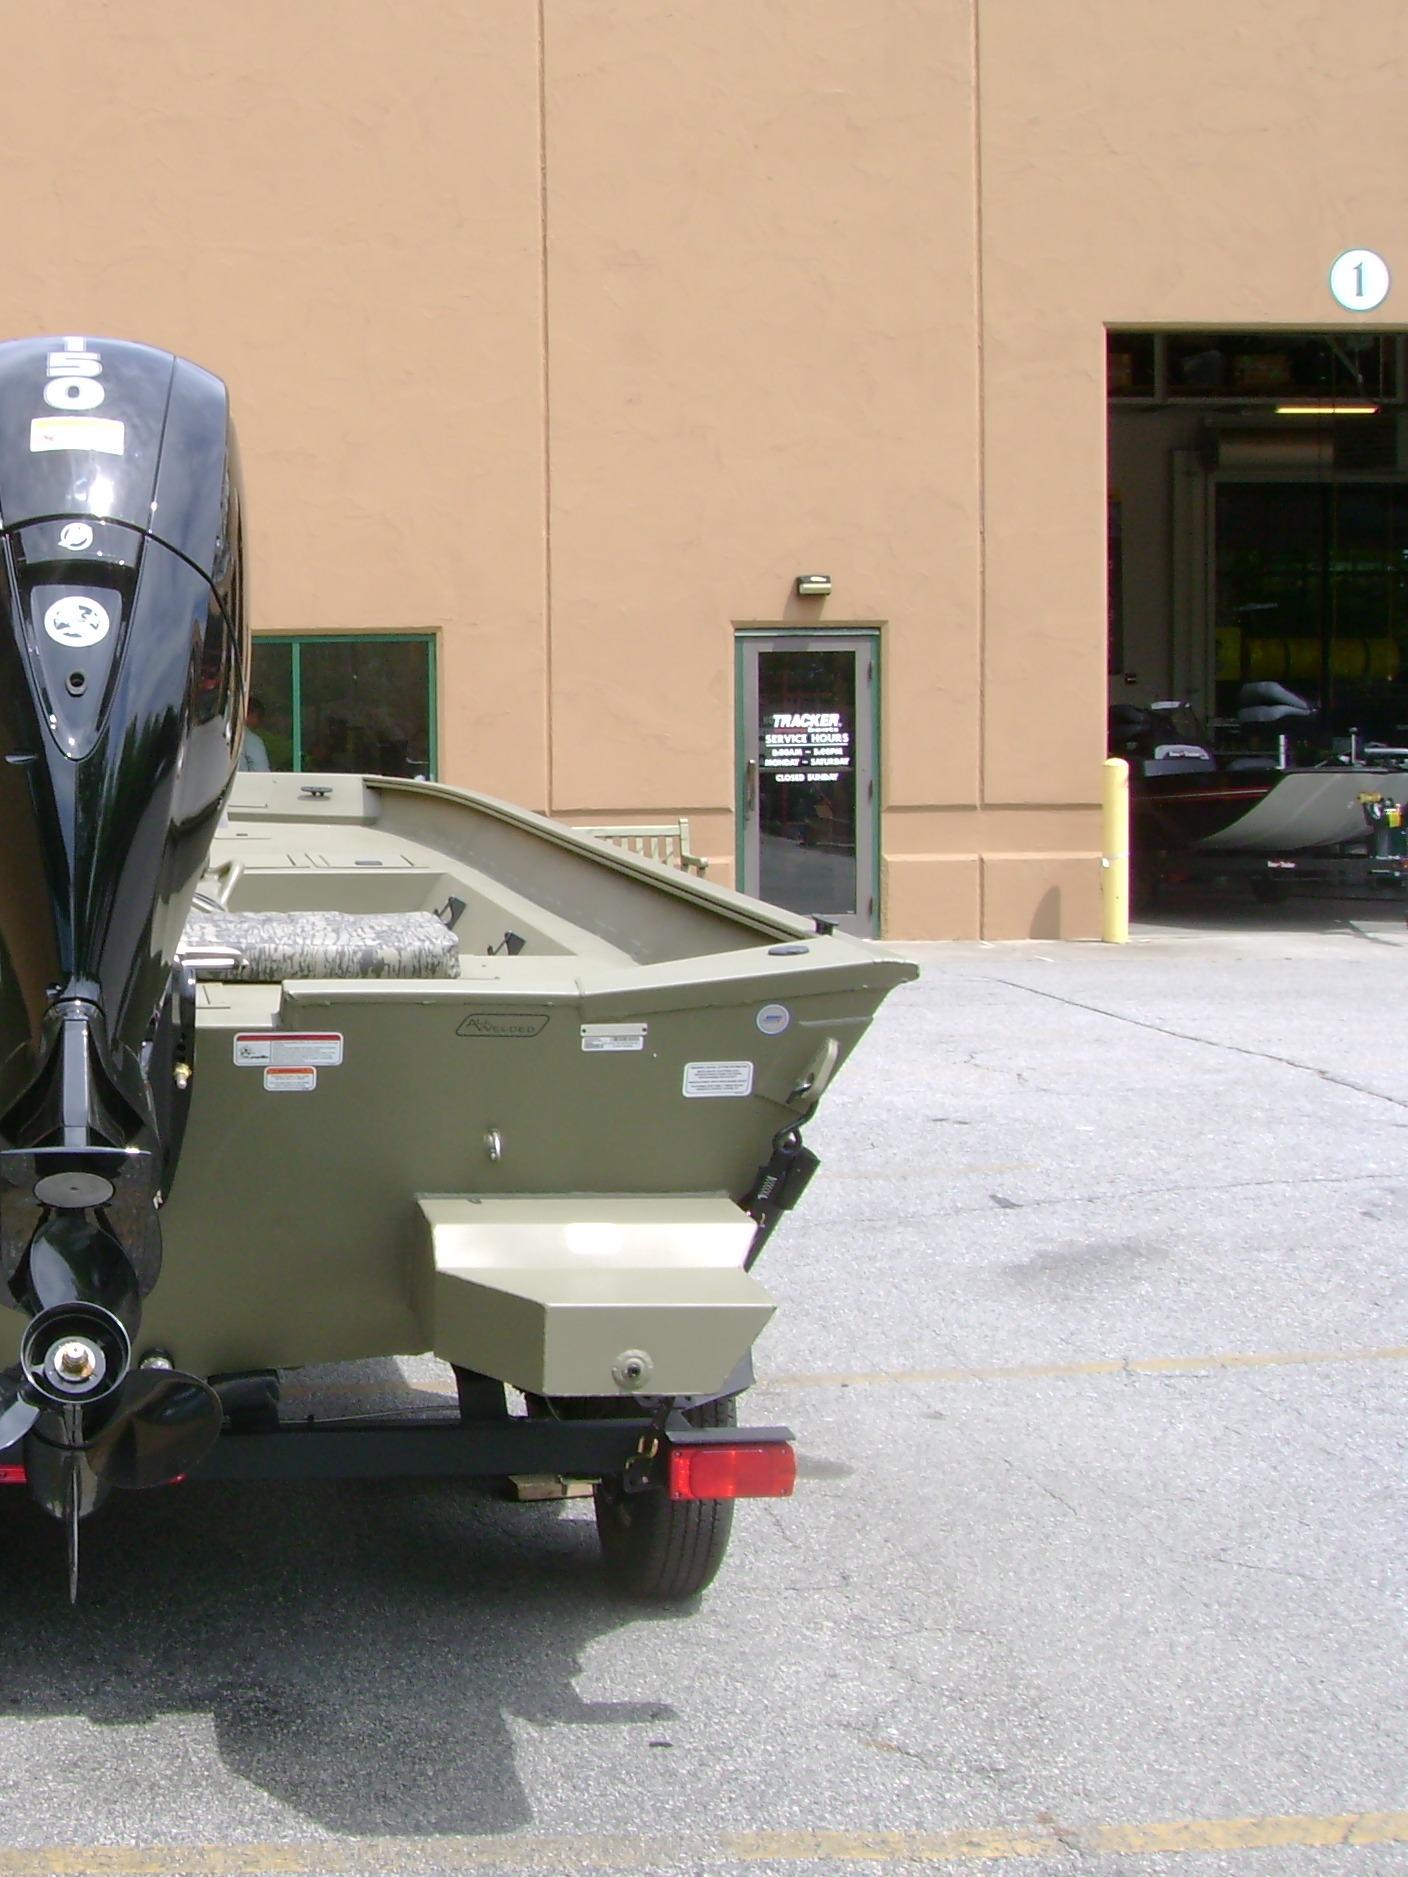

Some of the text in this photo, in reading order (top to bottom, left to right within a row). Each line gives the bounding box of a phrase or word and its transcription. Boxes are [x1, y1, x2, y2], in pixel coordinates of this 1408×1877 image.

[1353, 262, 1364, 296] 1
[773, 713, 840, 727] TRACKER
[765, 732, 849, 744] SERVICE HOURS
[775, 774, 805, 782] CLOSED
